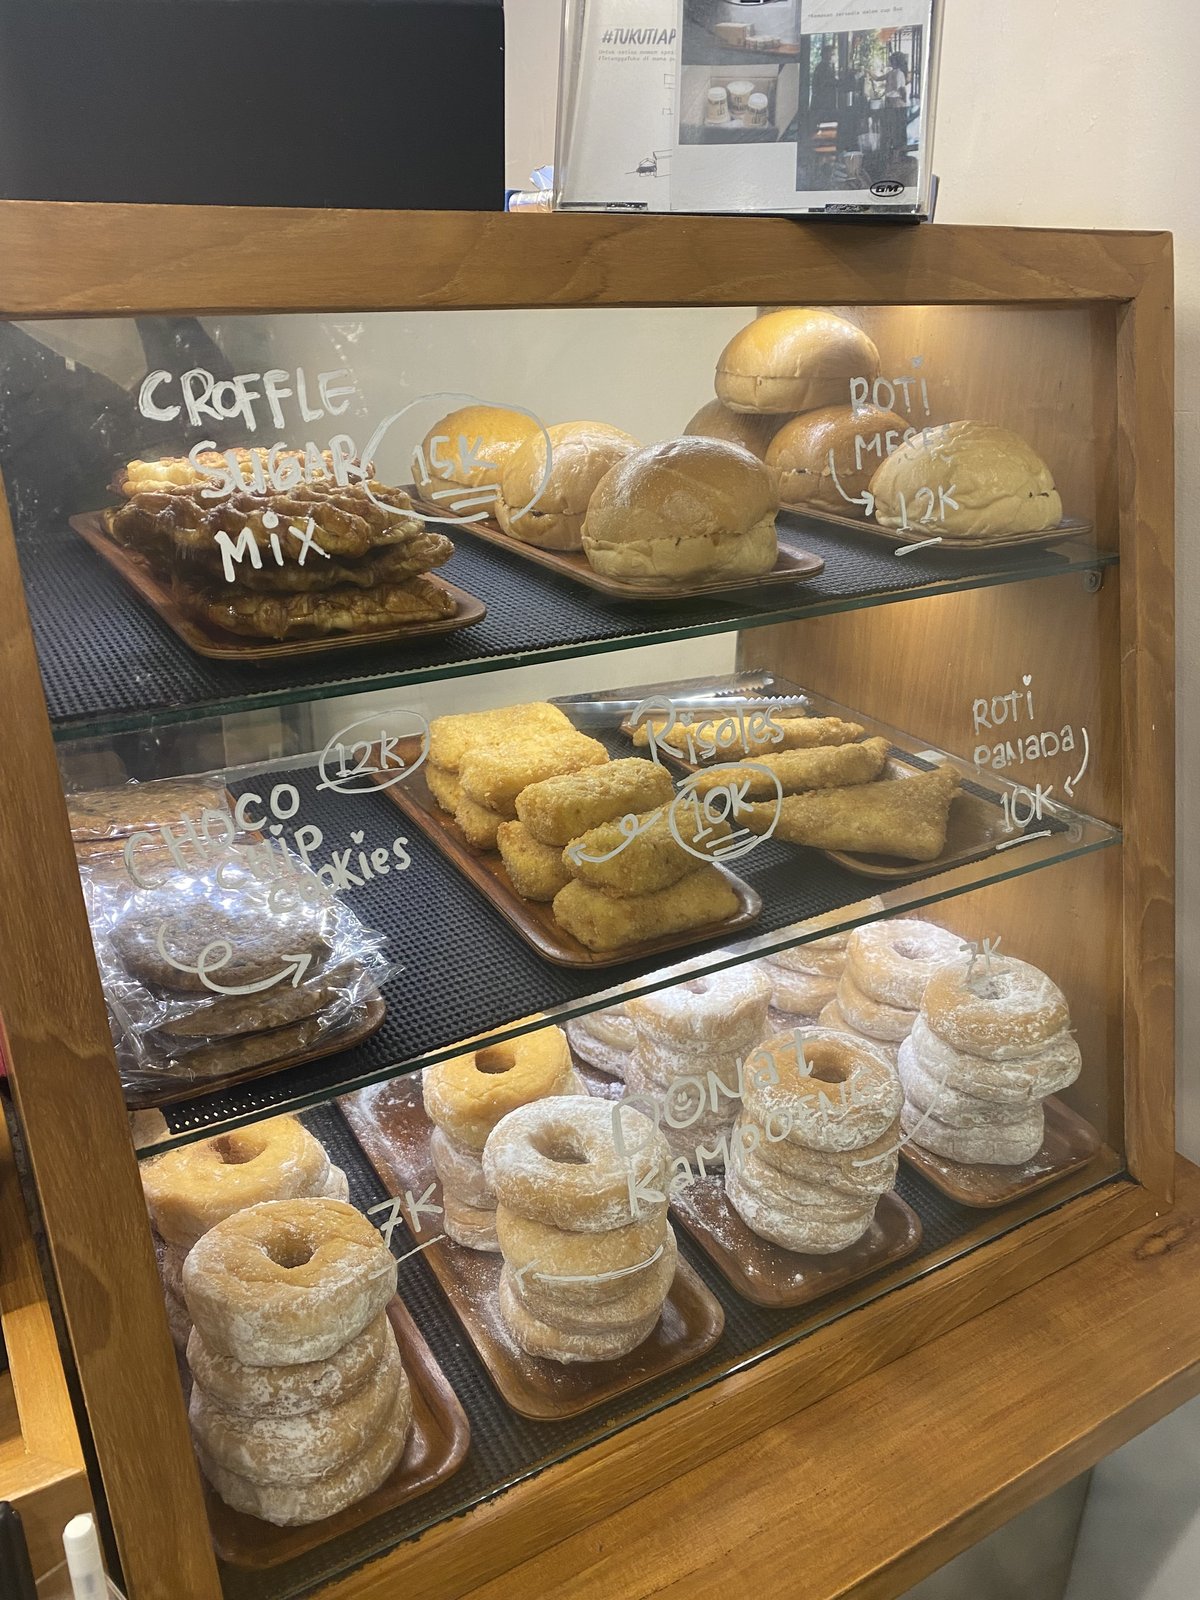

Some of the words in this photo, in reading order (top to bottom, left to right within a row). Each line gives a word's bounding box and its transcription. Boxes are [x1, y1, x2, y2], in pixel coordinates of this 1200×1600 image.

[602, 28, 677, 45] #TUKUTIAP
[139, 367, 356, 432] CROFFLE
[188, 434, 371, 498] SUGAR
[412, 435, 498, 487] 15K
[896, 483, 959, 534] 12K
[335, 729, 405, 778] 12K
[629, 695, 785, 766] Risoles
[124, 783, 300, 891] CHOCO
[683, 778, 754, 843] 10K
[1000, 783, 1057, 833] 10K
[367, 1182, 444, 1249] 7K
